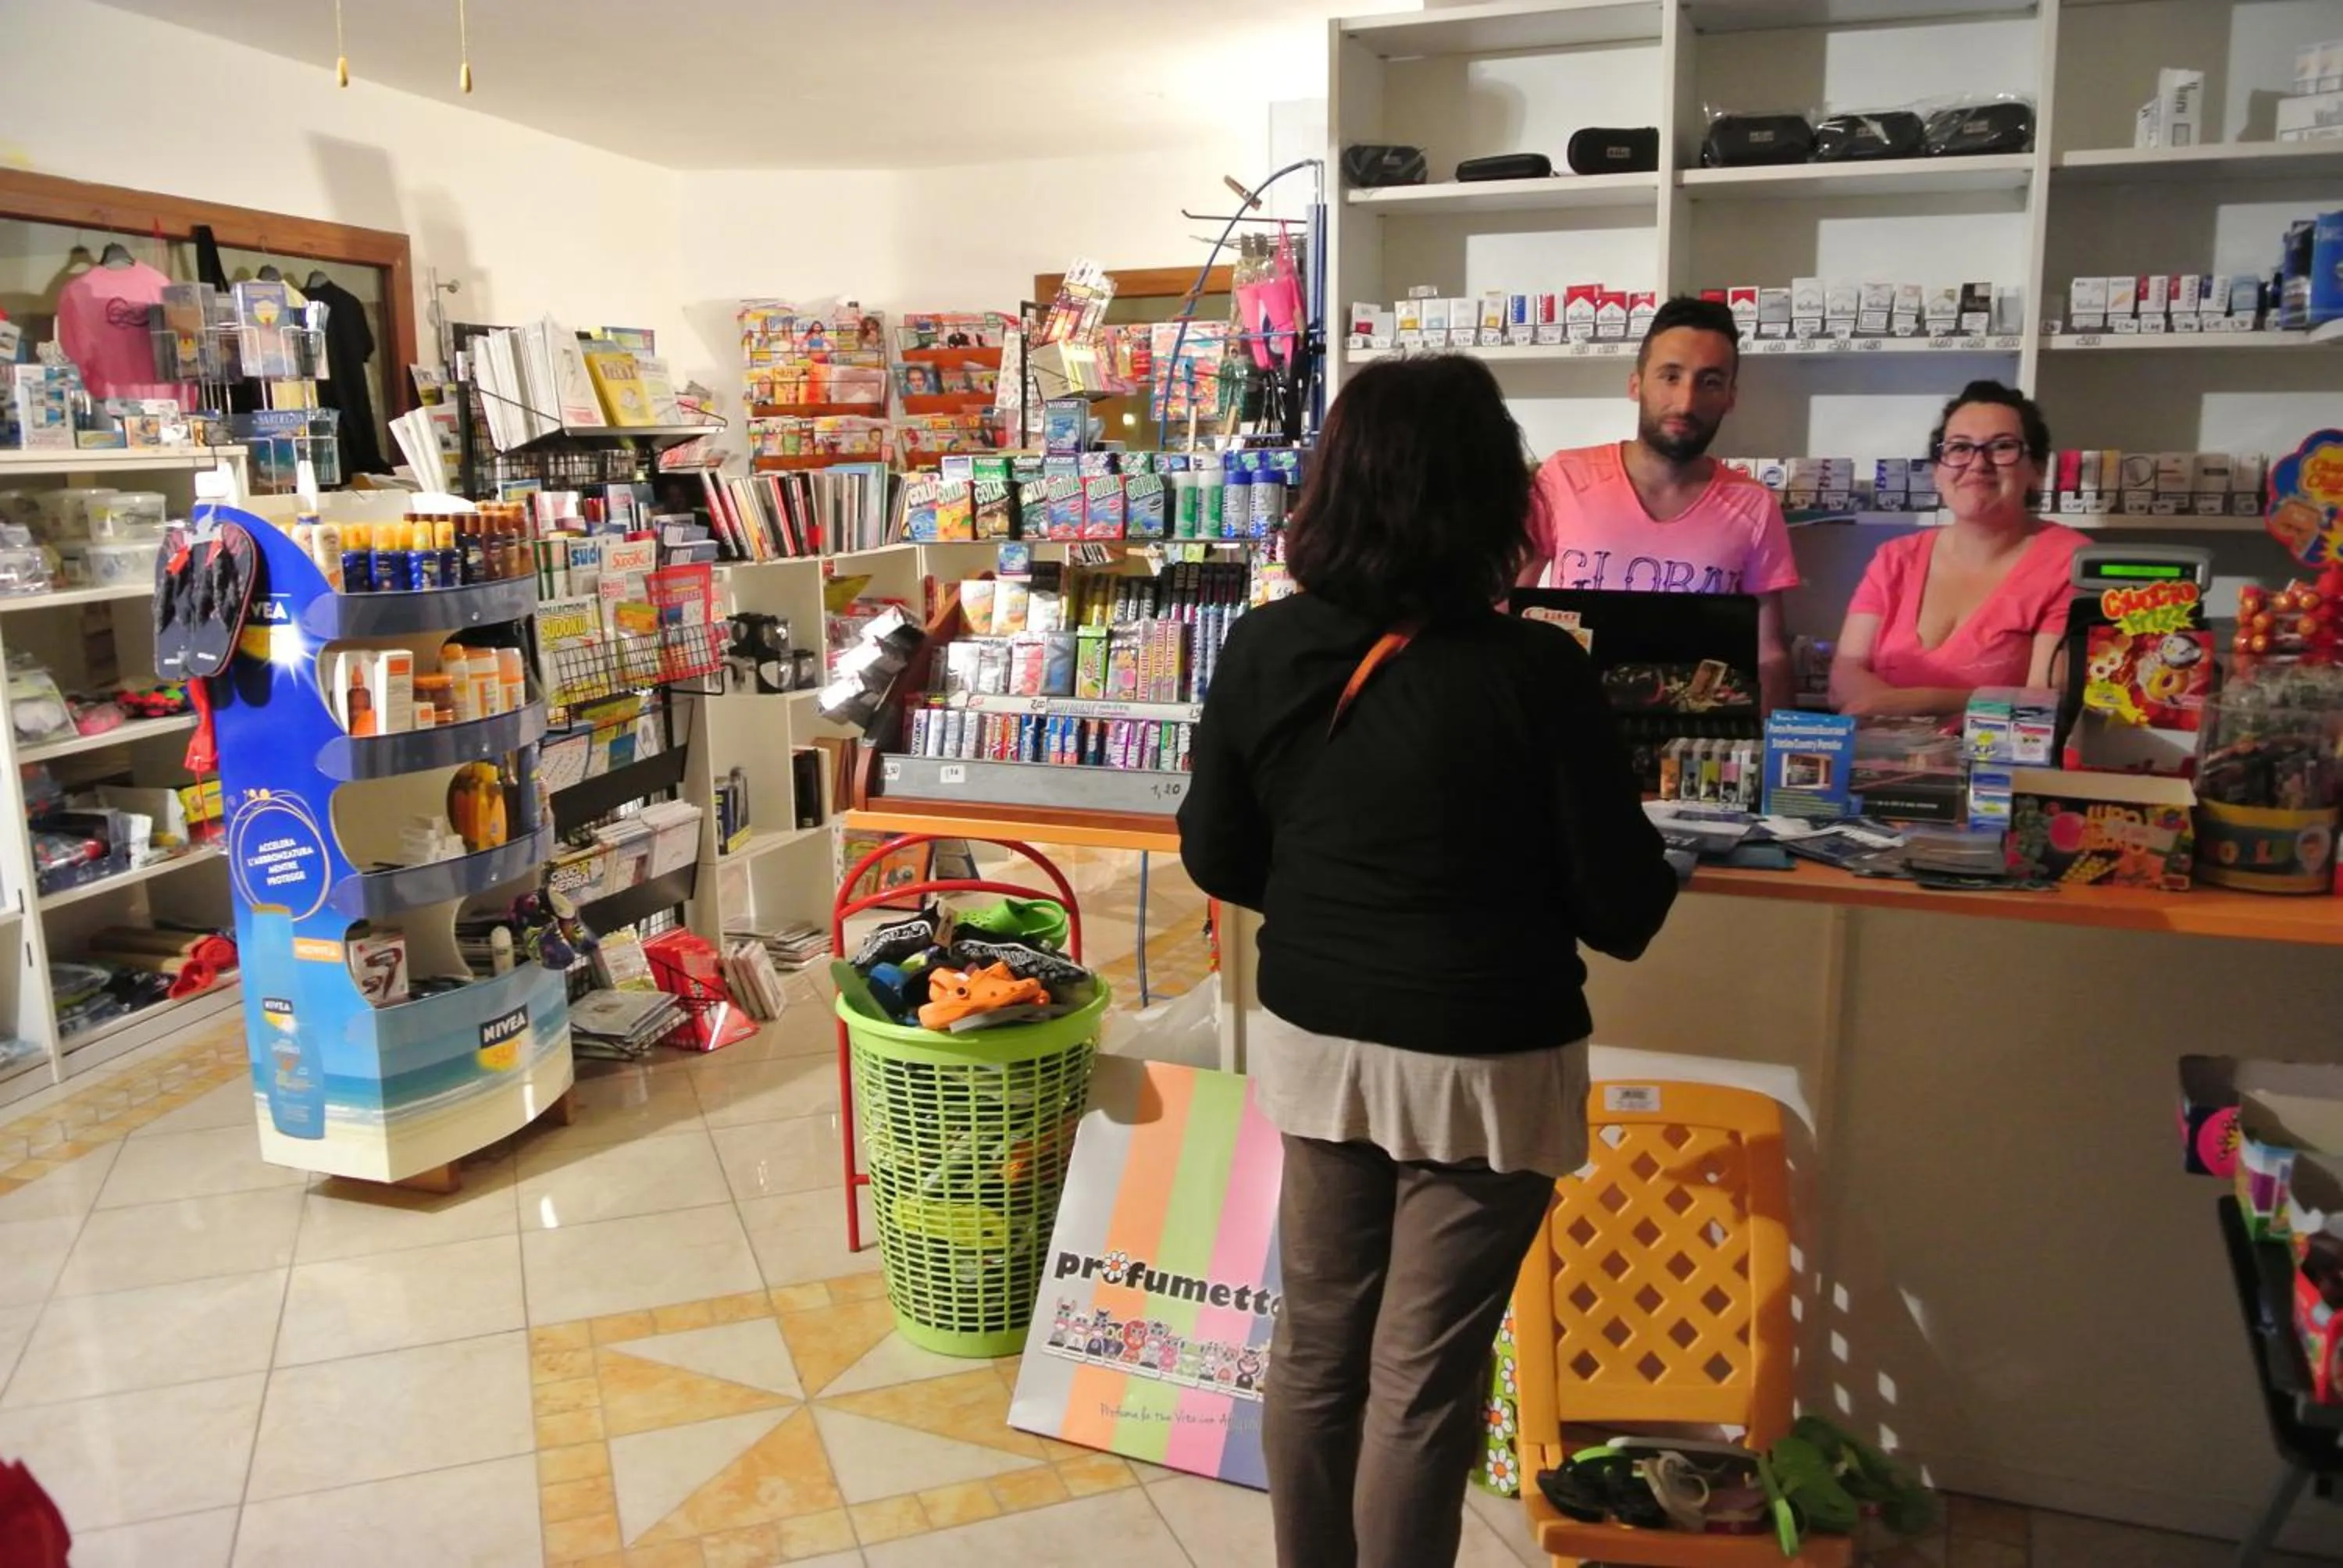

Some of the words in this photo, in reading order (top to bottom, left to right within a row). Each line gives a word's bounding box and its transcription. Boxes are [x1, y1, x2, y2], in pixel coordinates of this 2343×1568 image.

[975, 479, 1008, 505] GOLIA
[1086, 475, 1123, 501] GOLIA
[1125, 473, 1164, 501] GOLIA
[251, 600, 288, 619] VEA
[541, 615, 587, 639] SUDOKU
[265, 1000, 291, 1013] NIVEA
[483, 1011, 526, 1043] NIVEA
